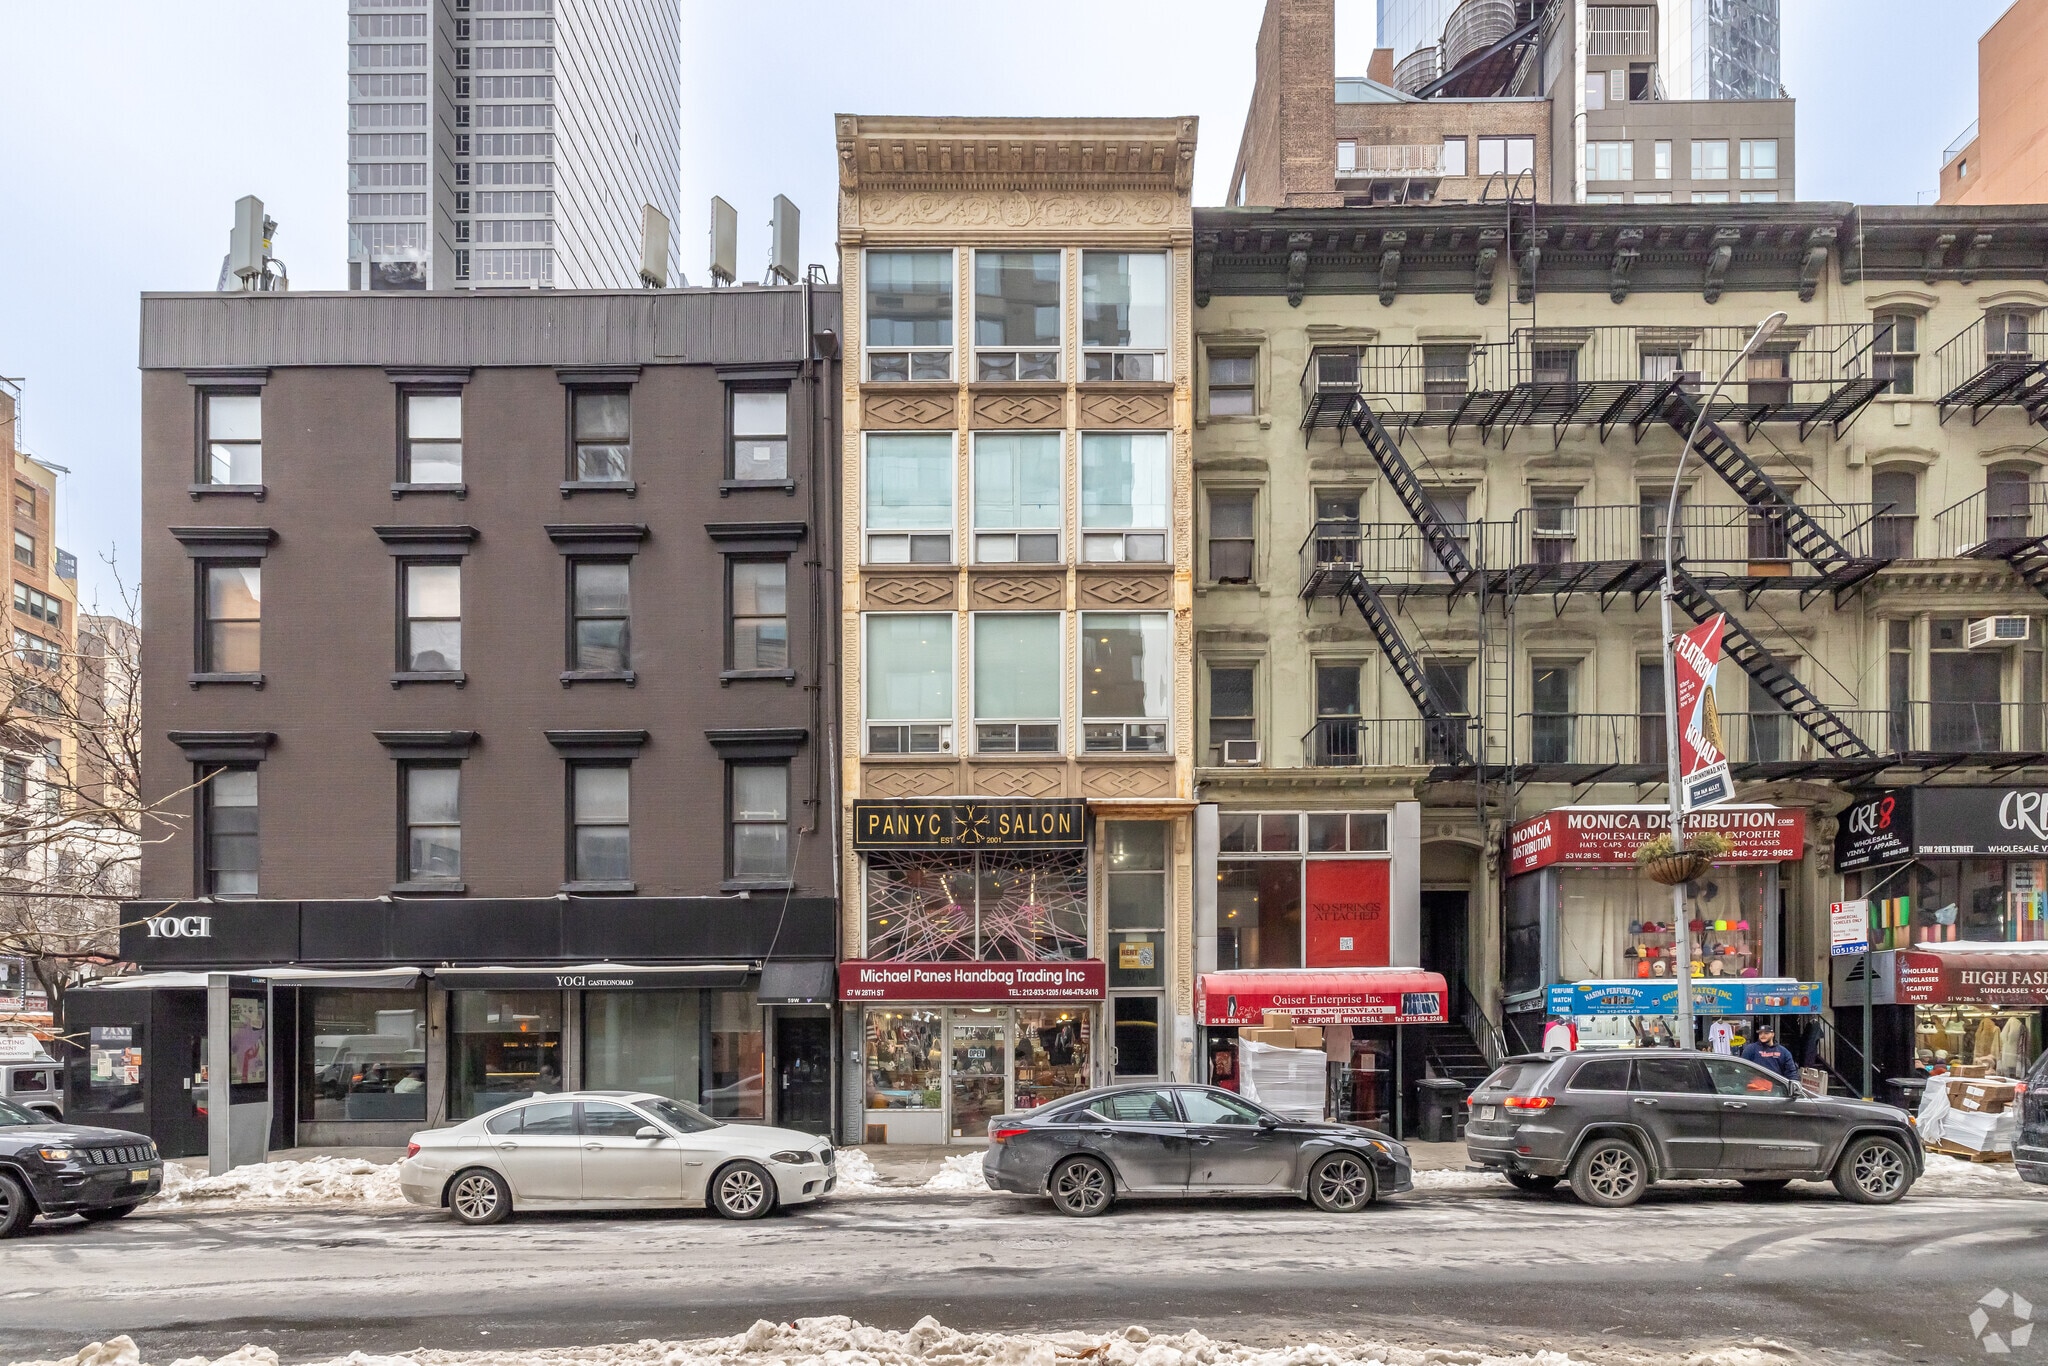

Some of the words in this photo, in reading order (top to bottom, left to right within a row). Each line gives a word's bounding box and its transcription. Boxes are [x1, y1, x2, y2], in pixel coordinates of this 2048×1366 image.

[1677, 633, 1717, 681] FLATIRON
[1685, 723, 1717, 765] NOMAD
[1567, 814, 1641, 829] MONICA
[1777, 818, 1794, 826] CORP
[1848, 796, 1896, 836] CRE8
[869, 814, 941, 835] PANYC
[999, 813, 1071, 834] SALON
[1512, 819, 1552, 845] MONICA
[1512, 834, 1552, 860] DISTRIBUTION
[1853, 832, 1893, 848] WHOLESALE
[1732, 849, 1794, 857] 646-272-9982
[1846, 847, 1866, 857] VINYL
[1873, 838, 1902, 850] APPAREL
[1919, 845, 1933, 853] 51W
[1934, 845, 1951, 853] 28TH
[1951, 845, 1974, 853] STREET
[1988, 845, 2039, 853] WHOLESALE
[1525, 855, 1538, 865] CORP
[1312, 903, 1330, 912] NO
[1331, 902, 1381, 912] SPRINGS
[1833, 904, 1840, 912] 3
[1314, 911, 1379, 921] ATTACHED
[143, 916, 212, 937] YOGI
[556, 976, 586, 987] YOGI
[860, 969, 911, 982] Michael
[914, 969, 951, 982] Panes
[954, 969, 1014, 985] Handbag
[1016, 968, 1062, 985] Trading
[1065, 968, 1085, 982] Inc
[1961, 971, 2007, 985] HIGH
[1606, 986, 1631, 995] PERFUME
[1661, 990, 1679, 1002] GUP
[1272, 994, 1306, 1006] Qaiser
[1309, 993, 1362, 1006] Enterprise
[1365, 993, 1385, 1004] Inc.
[1307, 1016, 1335, 1024] EXPORT
[1342, 1015, 1384, 1023] WHOLESALE
